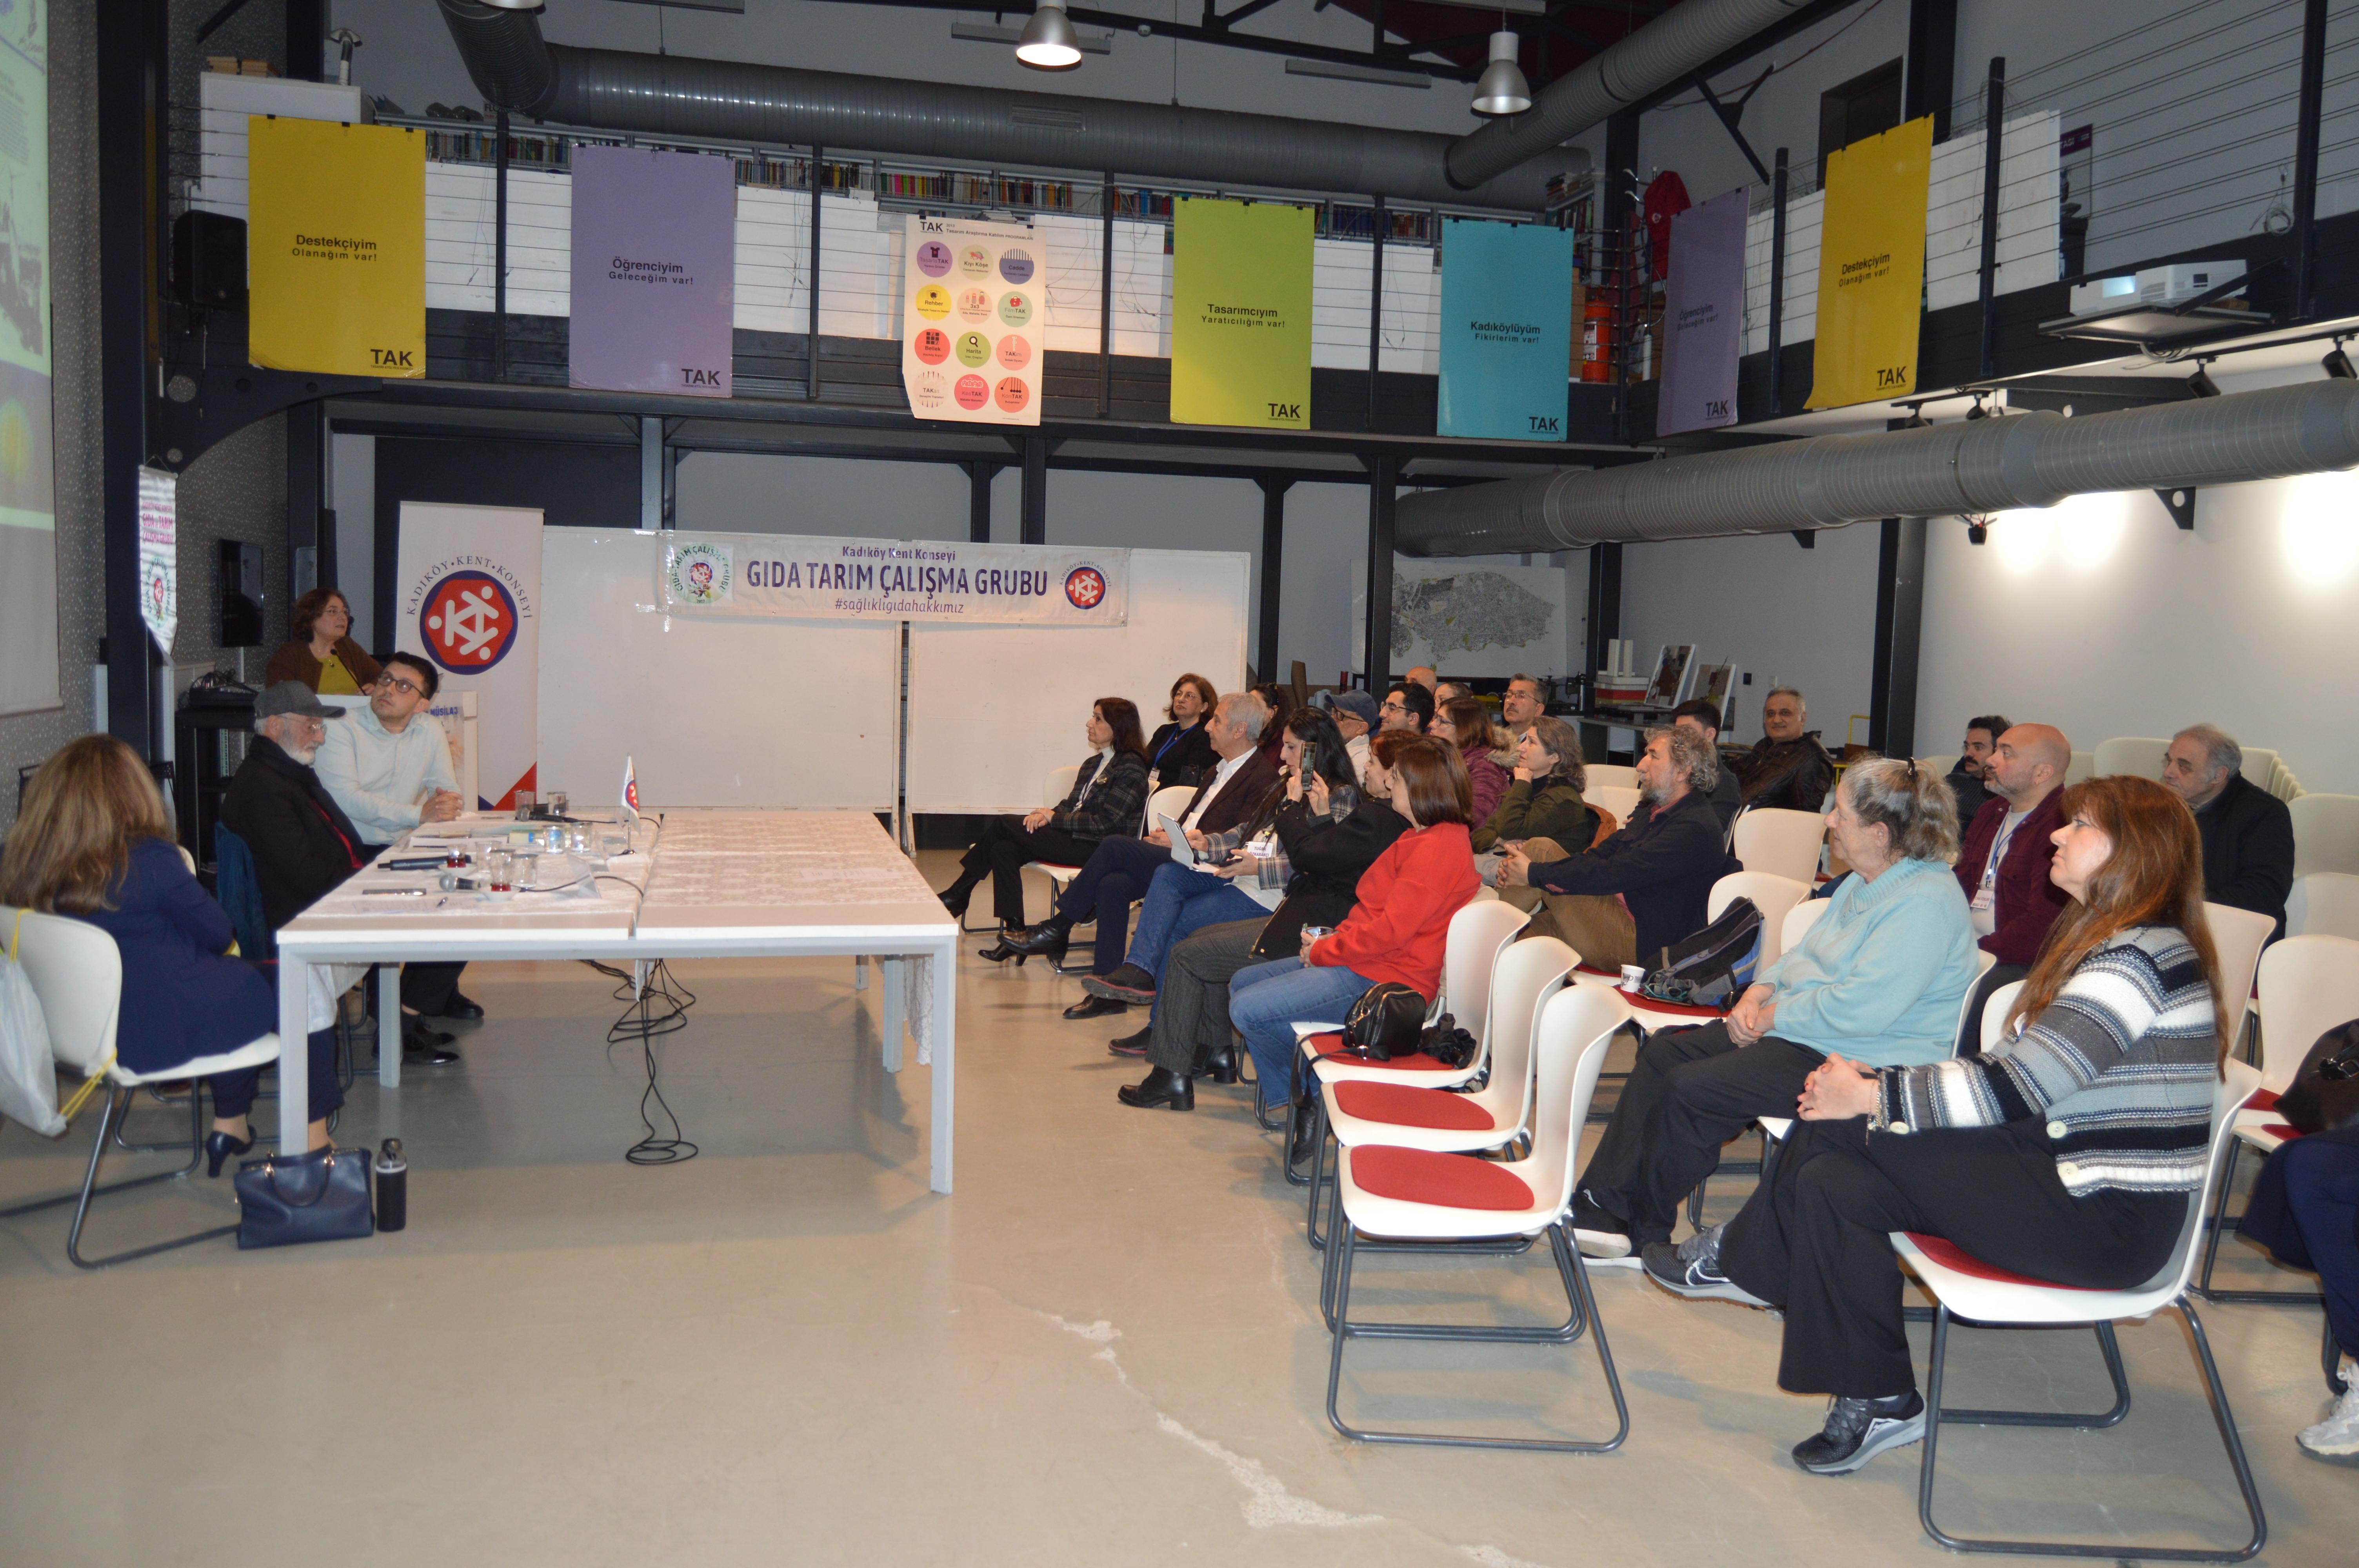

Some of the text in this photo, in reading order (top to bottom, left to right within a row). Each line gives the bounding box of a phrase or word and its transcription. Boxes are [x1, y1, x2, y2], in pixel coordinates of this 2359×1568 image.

[920, 221, 943, 232] TAK
[296, 235, 376, 250] Destekçiyim
[292, 248, 348, 260] Olanağım
[613, 256, 683, 274] Öğrenciyim
[1842, 253, 1890, 275] Destekçiyim
[609, 271, 667, 283] Geleceğim
[1839, 266, 1889, 287] Olanağım var!
[1208, 304, 1278, 318] Tasarımcıyım
[1680, 304, 1713, 321] Öğrenciyim
[1706, 314, 1718, 323] var!
[1202, 316, 1263, 327] Yaratıcılığım
[1471, 321, 1540, 335] Kadıköylüyüm
[1475, 334, 1518, 342] Fikirlerim
[370, 349, 413, 367] TAK
[682, 368, 720, 385] TAK
[1877, 366, 1906, 386] TAK
[1268, 403, 1300, 418] TAK
[1706, 400, 1728, 416] TAK
[1529, 417, 1559, 431] TAK
[843, 546, 955, 563] Kadıköy Kent Konseyi
[407, 555, 533, 619] KADIKÖY KENT KONSEYİ
[747, 561, 801, 588] GIDA
[806, 563, 872, 590] TARIM
[880, 565, 969, 599] ÇALIŞMA
[975, 569, 1047, 596] GRUBU
[835, 598, 964, 614] #sağlıklıgıdahakkımız
[430, 706, 458, 717] MÜSİLAJ
